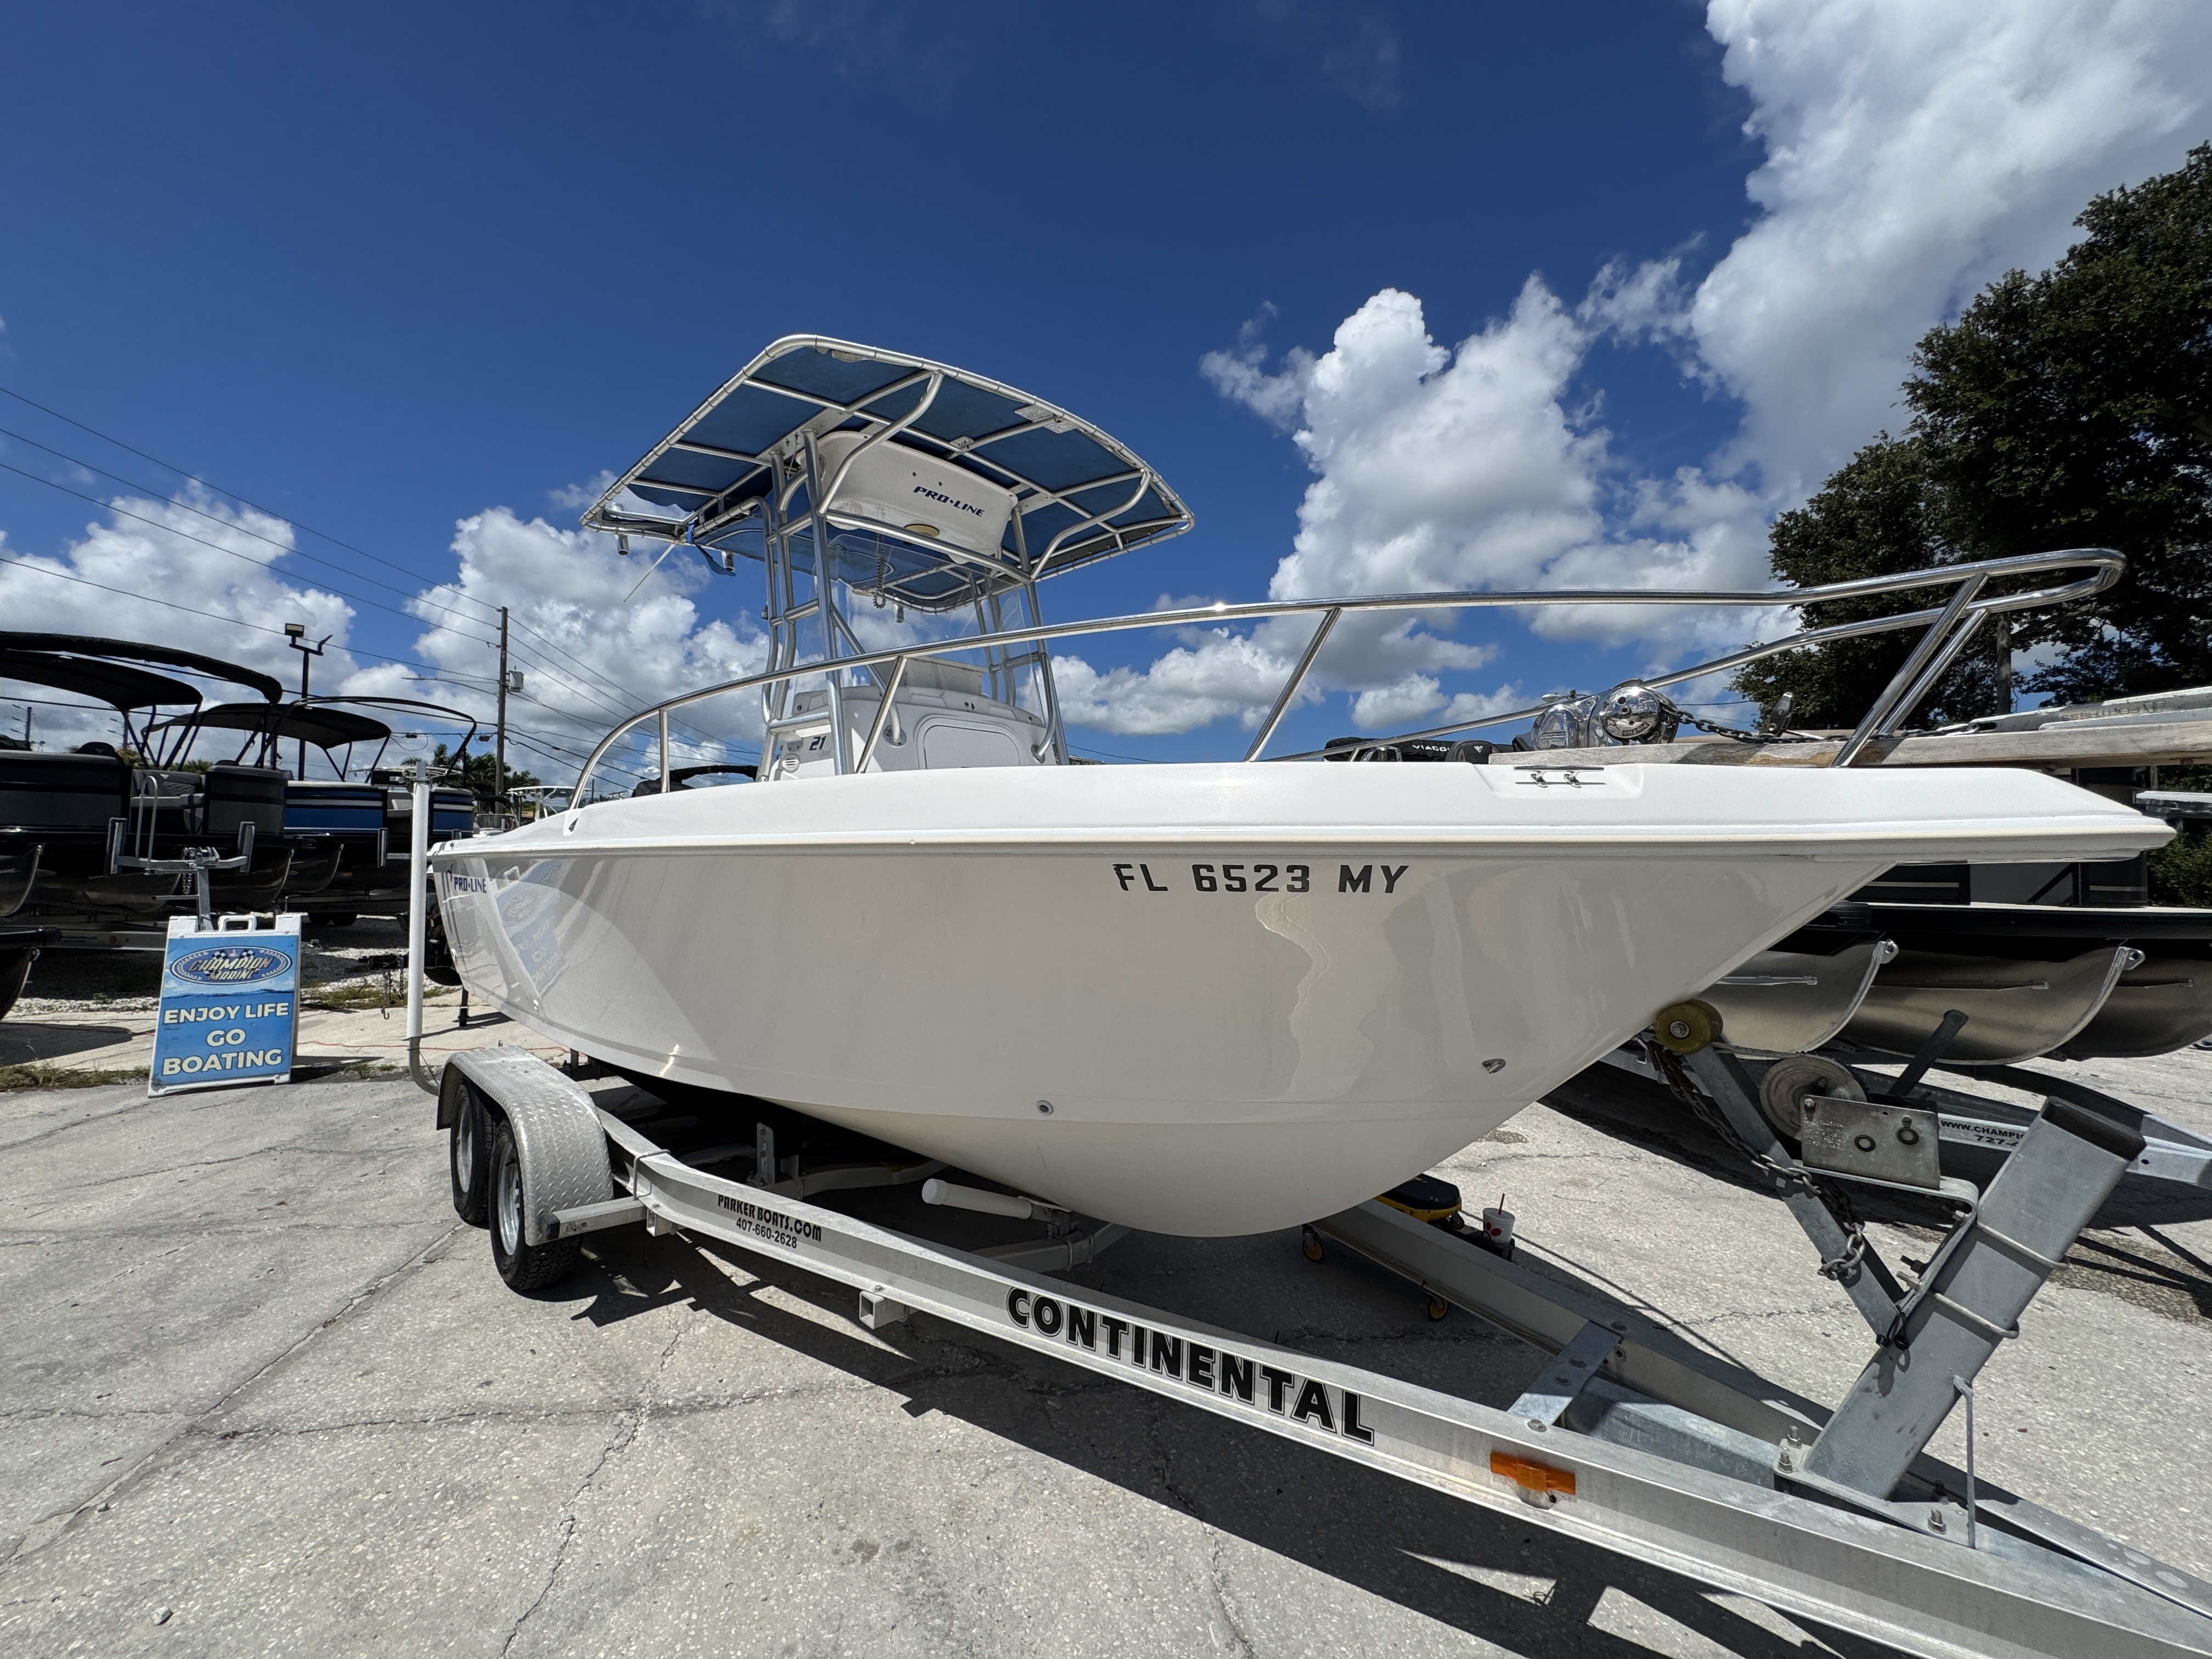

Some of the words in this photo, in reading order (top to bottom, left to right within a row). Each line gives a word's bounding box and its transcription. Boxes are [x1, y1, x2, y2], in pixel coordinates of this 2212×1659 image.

[809, 736, 827, 751] 21
[1112, 864, 1169, 892] FL
[1192, 864, 1310, 893] 6523
[1338, 865, 1409, 894] MY
[188, 957, 275, 972] CHAMPION
[208, 969, 259, 981] MARINE
[163, 1005, 241, 1024] ENJOY
[245, 1002, 290, 1019] LIFE
[206, 1029, 246, 1047] GO
[162, 1049, 283, 1076] BOATING
[718, 1194, 755, 1219] PARKER
[736, 1217, 797, 1249] 407-660-2628
[1006, 1286, 1375, 1447] CONTINENTAL
